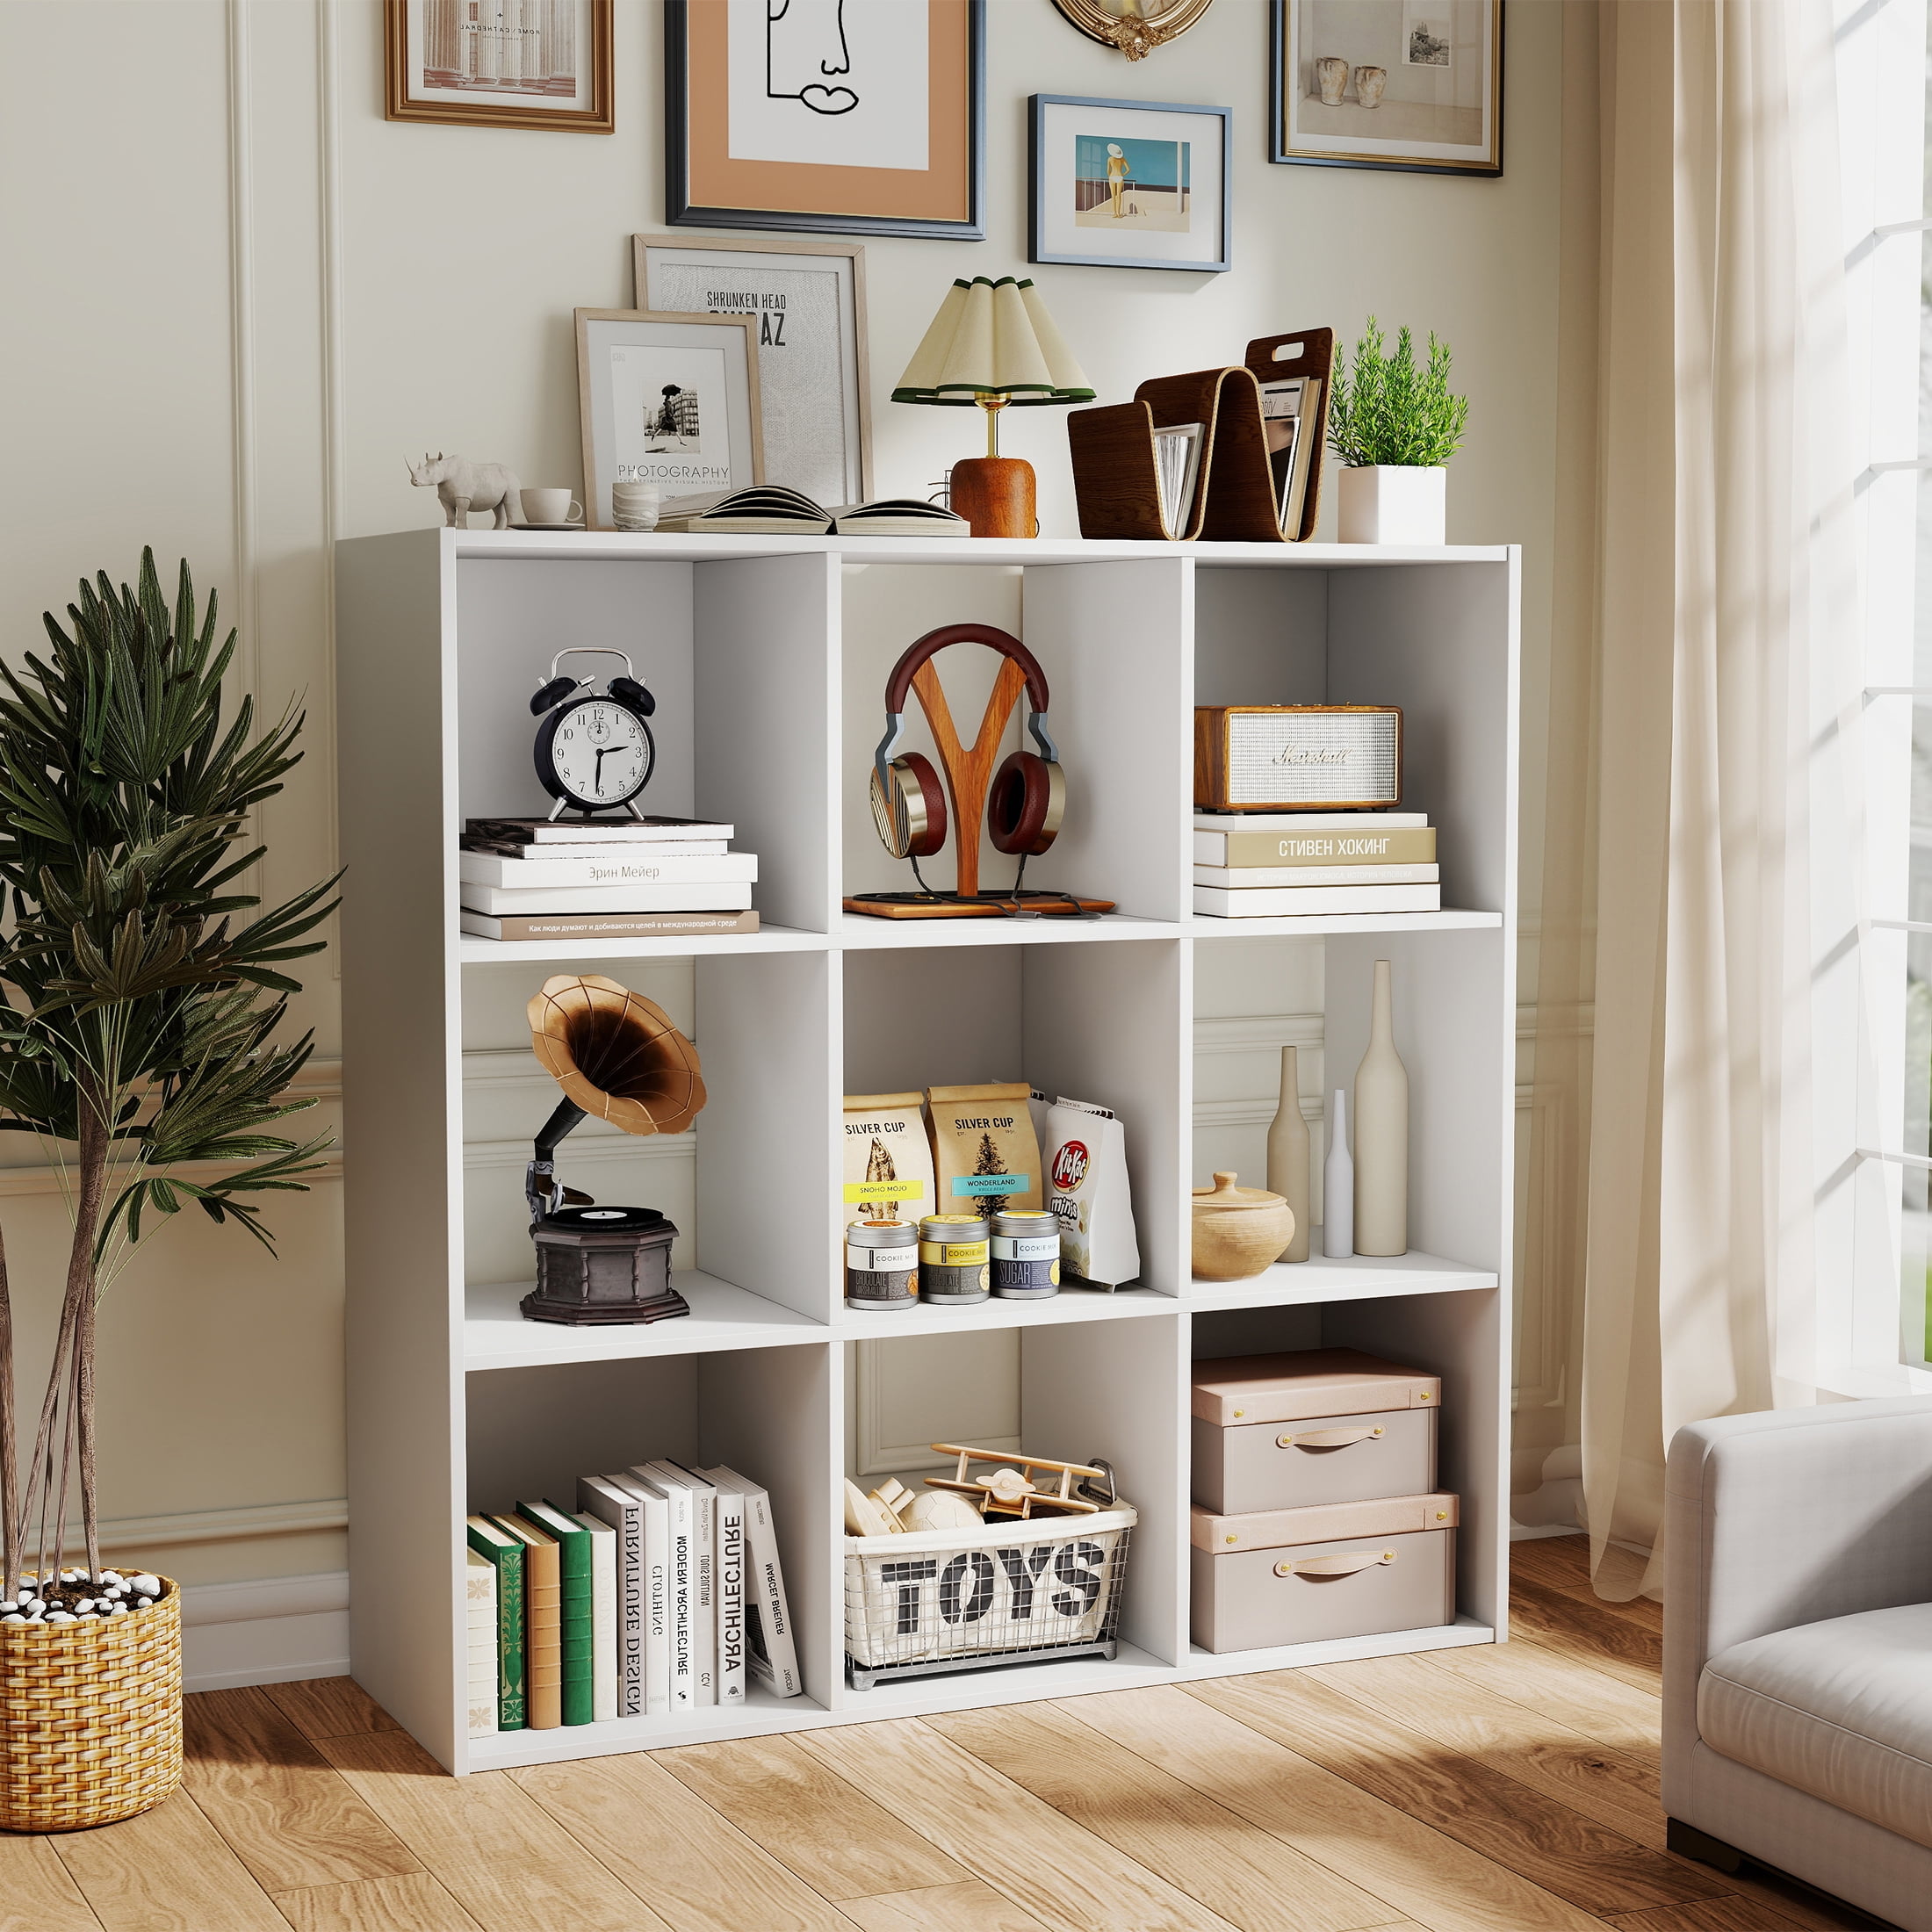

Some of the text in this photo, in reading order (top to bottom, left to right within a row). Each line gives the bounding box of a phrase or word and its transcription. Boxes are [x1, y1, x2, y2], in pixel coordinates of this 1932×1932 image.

[707, 291, 786, 309] SHRUNKEN HEAD
[618, 465, 729, 479] PHOTOGRAPHY
[577, 714, 586, 725] 11
[594, 709, 604, 720] 12
[563, 729, 573, 740] 10
[629, 727, 636, 738] 2
[557, 748, 565, 760] 9
[635, 746, 642, 758] 3
[563, 767, 571, 778] 8
[629, 767, 637, 777] 4
[579, 781, 586, 792] 7
[597, 786, 604, 797] 6
[618, 780, 625, 791] 5
[1279, 838, 1390, 857] СТИВЕН ХОКИНГ
[589, 866, 660, 881] Эрин Мейер
[595, 922, 634, 931] добиваются
[662, 919, 716, 928] международной
[845, 1121, 905, 1135] SILVER CUP
[955, 1117, 1013, 1129] SILVER CUP
[1050, 1196, 1078, 1220] minis
[999, 1261, 1030, 1284] SUGAR
[856, 1271, 887, 1287] CHOCOLATE
[881, 1541, 1105, 1635] TOYS
